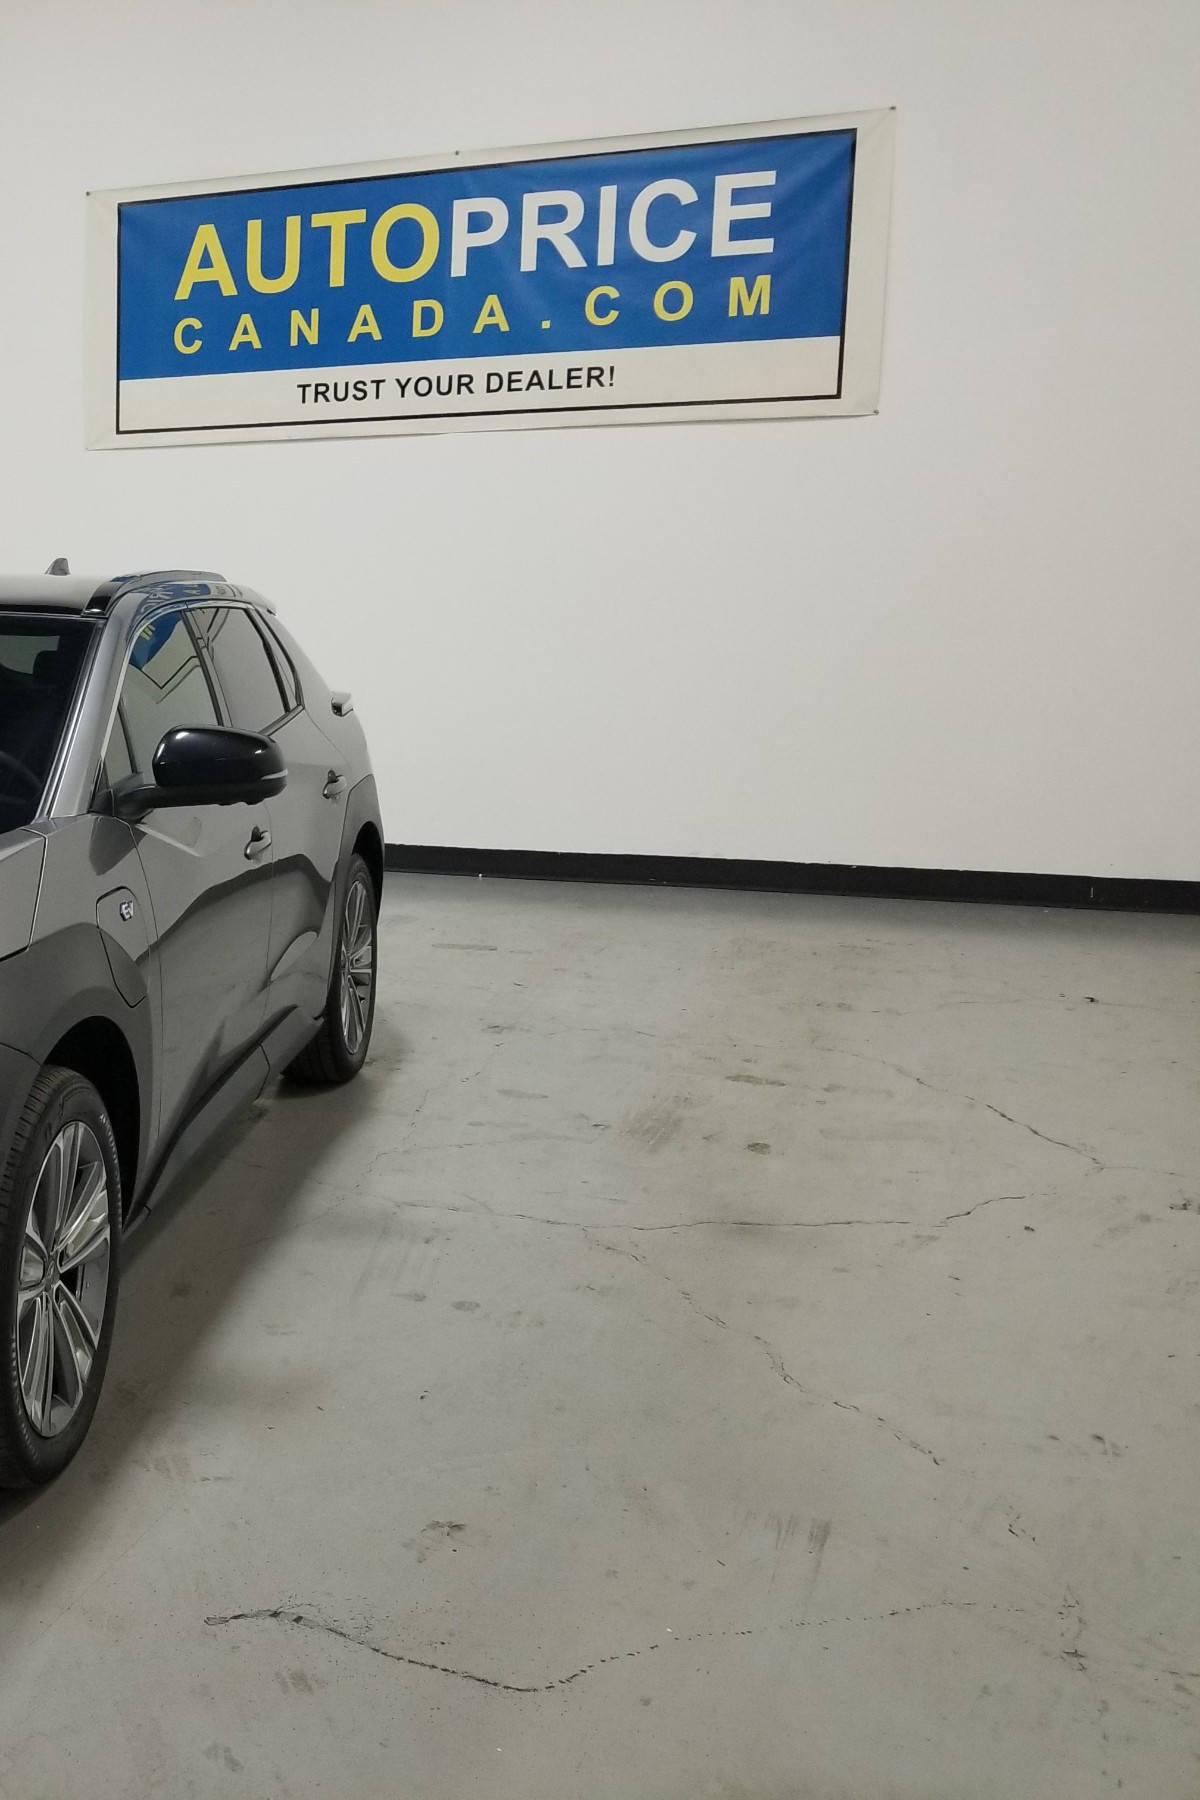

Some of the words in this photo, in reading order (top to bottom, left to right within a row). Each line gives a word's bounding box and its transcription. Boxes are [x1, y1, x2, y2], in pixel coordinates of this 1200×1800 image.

[175, 170, 777, 300] AUTOPRICE
[296, 378, 386, 404] TRUST
[394, 373, 475, 399] YOUR
[485, 365, 616, 394] DEALER!
